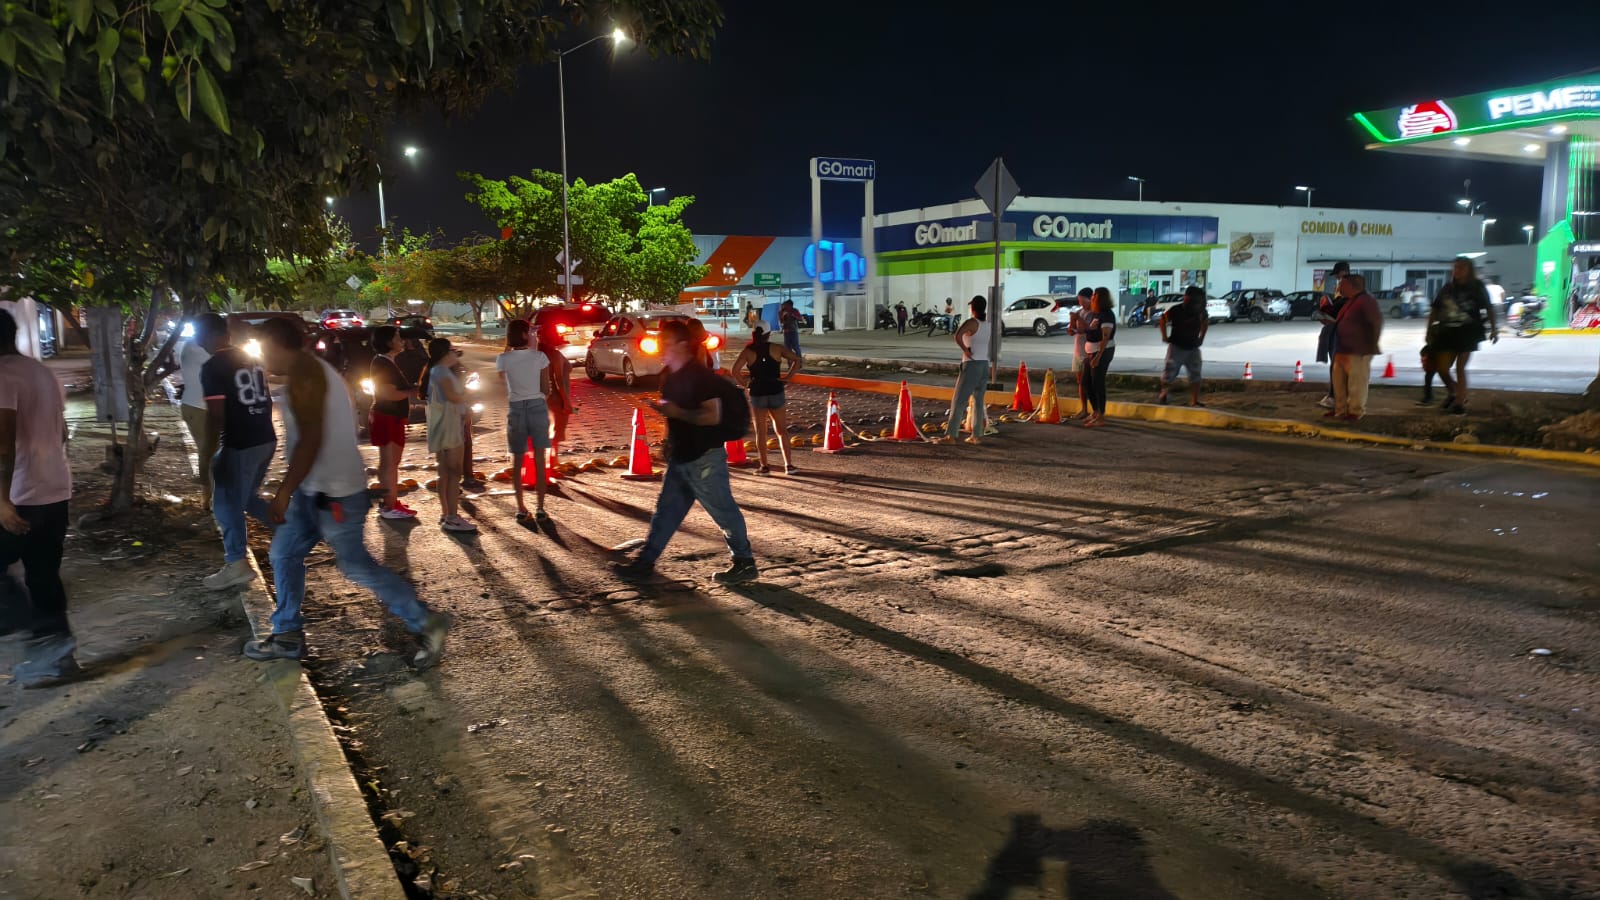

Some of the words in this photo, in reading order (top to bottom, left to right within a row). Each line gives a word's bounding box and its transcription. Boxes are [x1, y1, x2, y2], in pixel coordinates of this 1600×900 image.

[819, 161, 874, 177] GOmart
[1033, 214, 1113, 239] GOmart
[1301, 221, 1345, 234] COMIDA
[1361, 223, 1393, 236] CHINA
